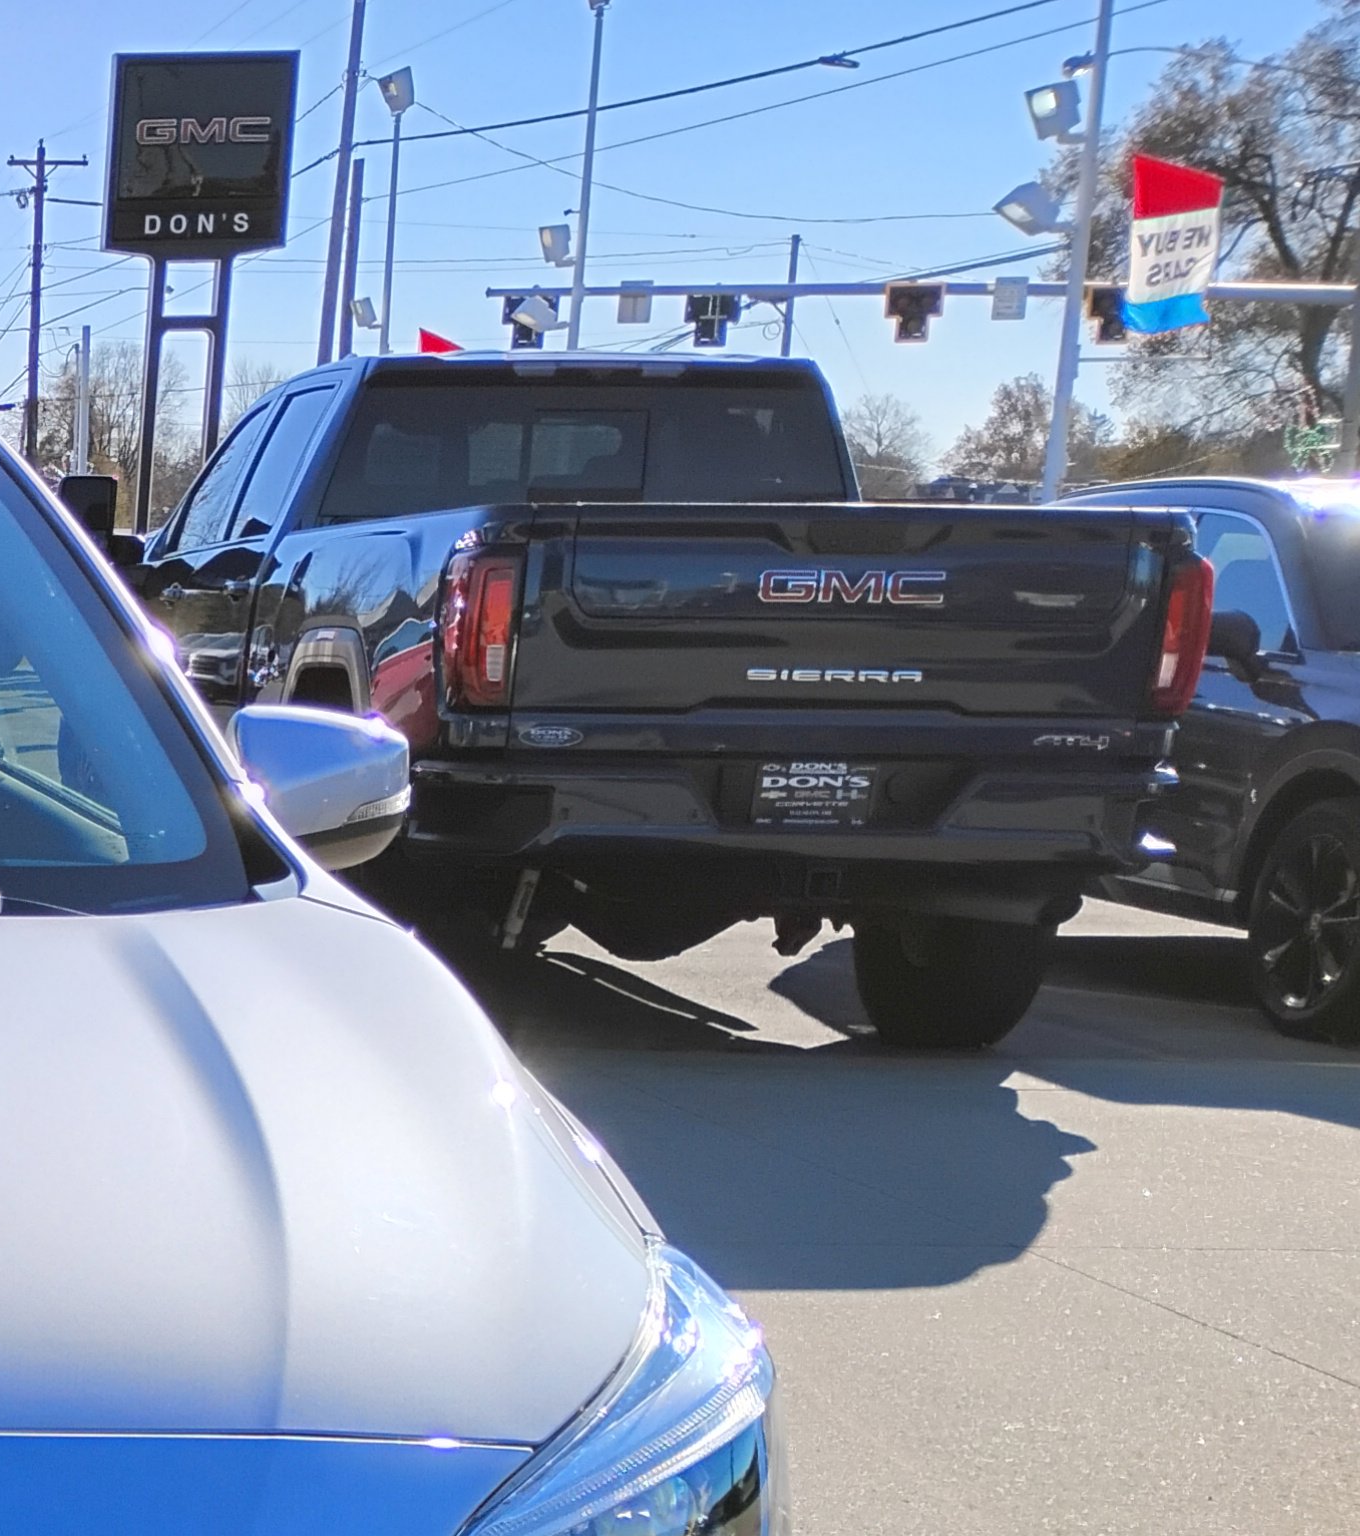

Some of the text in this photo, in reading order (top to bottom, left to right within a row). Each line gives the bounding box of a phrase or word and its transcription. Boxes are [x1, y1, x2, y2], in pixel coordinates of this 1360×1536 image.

[136, 117, 271, 145] GMC
[144, 212, 250, 235] DON'S
[758, 569, 946, 604] GMC
[747, 668, 923, 683] SIERRA
[762, 776, 871, 788] DON'S
